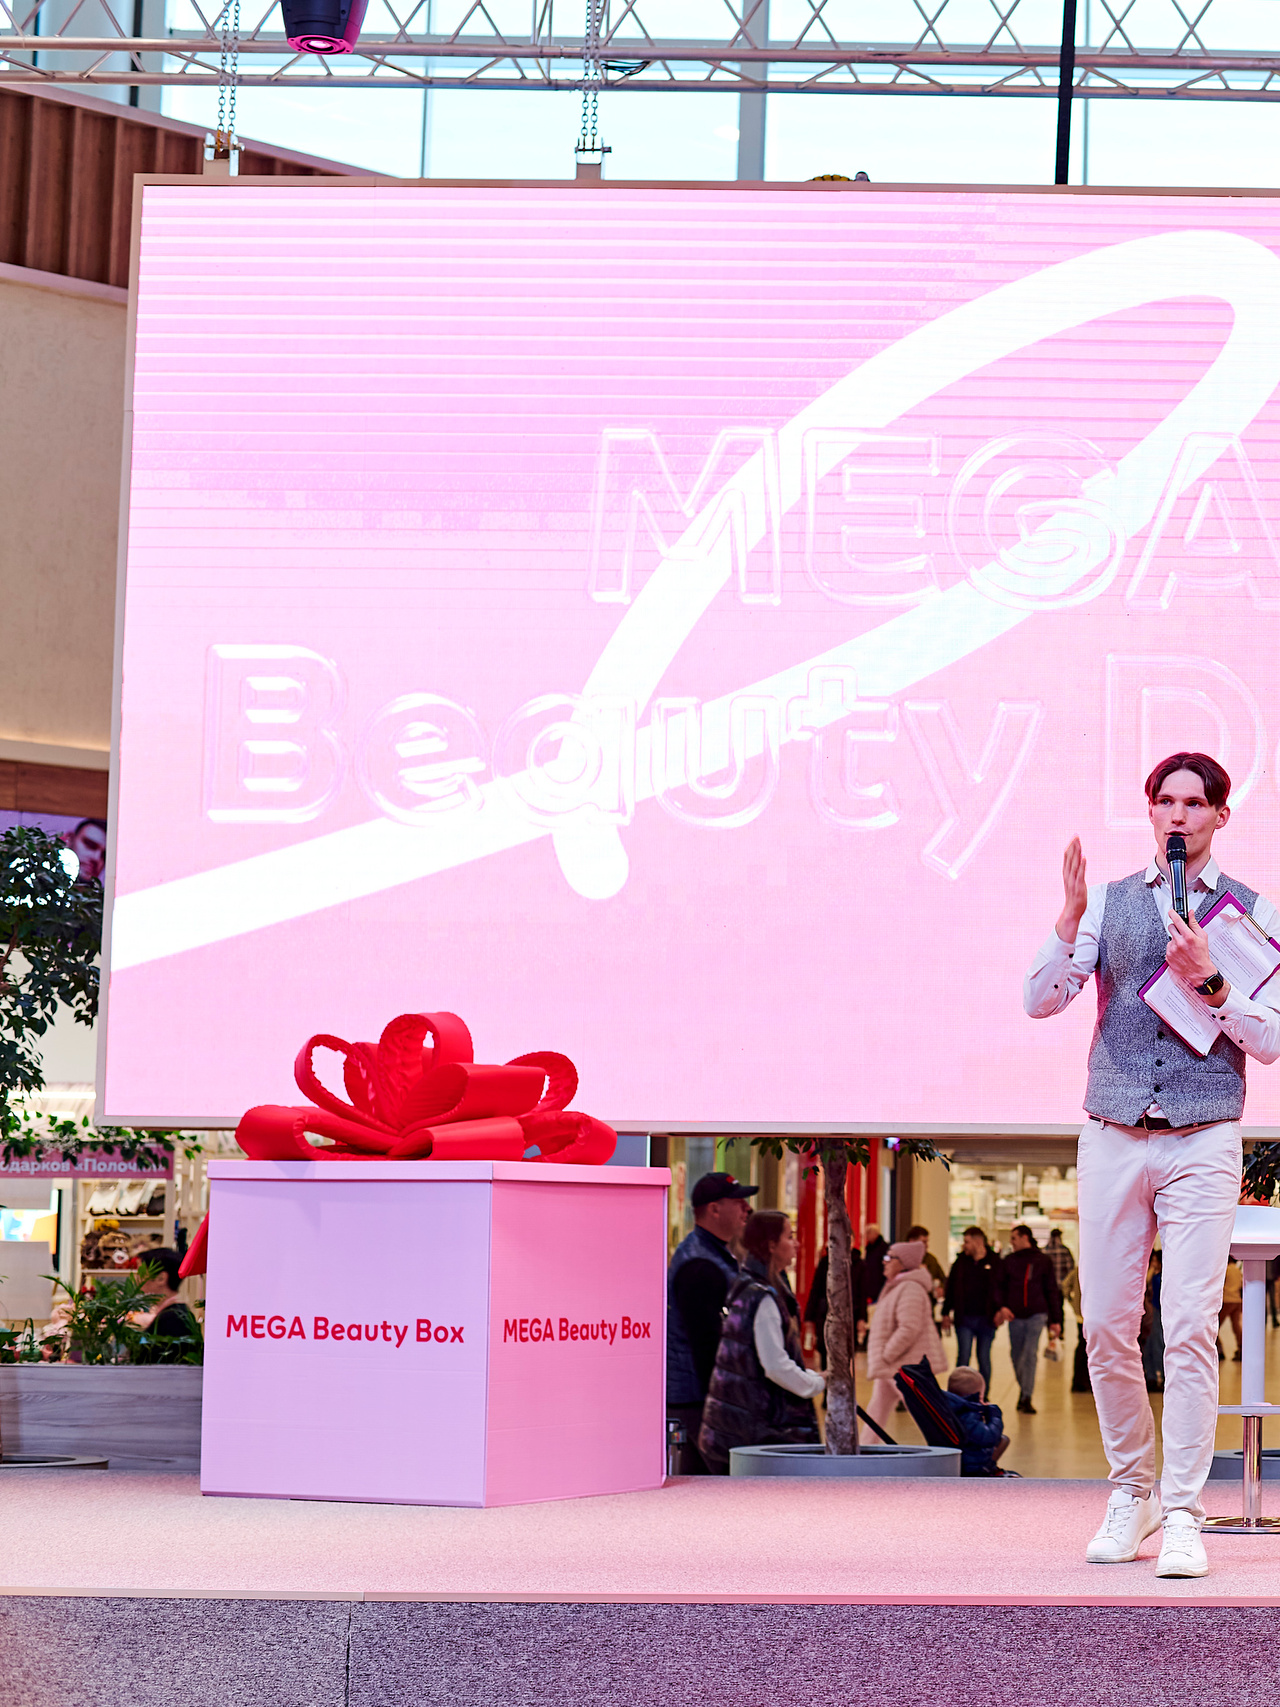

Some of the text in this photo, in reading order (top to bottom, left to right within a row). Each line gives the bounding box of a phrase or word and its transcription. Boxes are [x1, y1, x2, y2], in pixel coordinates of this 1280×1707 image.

[202, 642, 1045, 880] Beauty
[74, 1157, 166, 1172] «Полоч»
[226, 1314, 465, 1349] MEGA Beauty Box
[503, 1316, 651, 1346] MEGA Beauty Box
